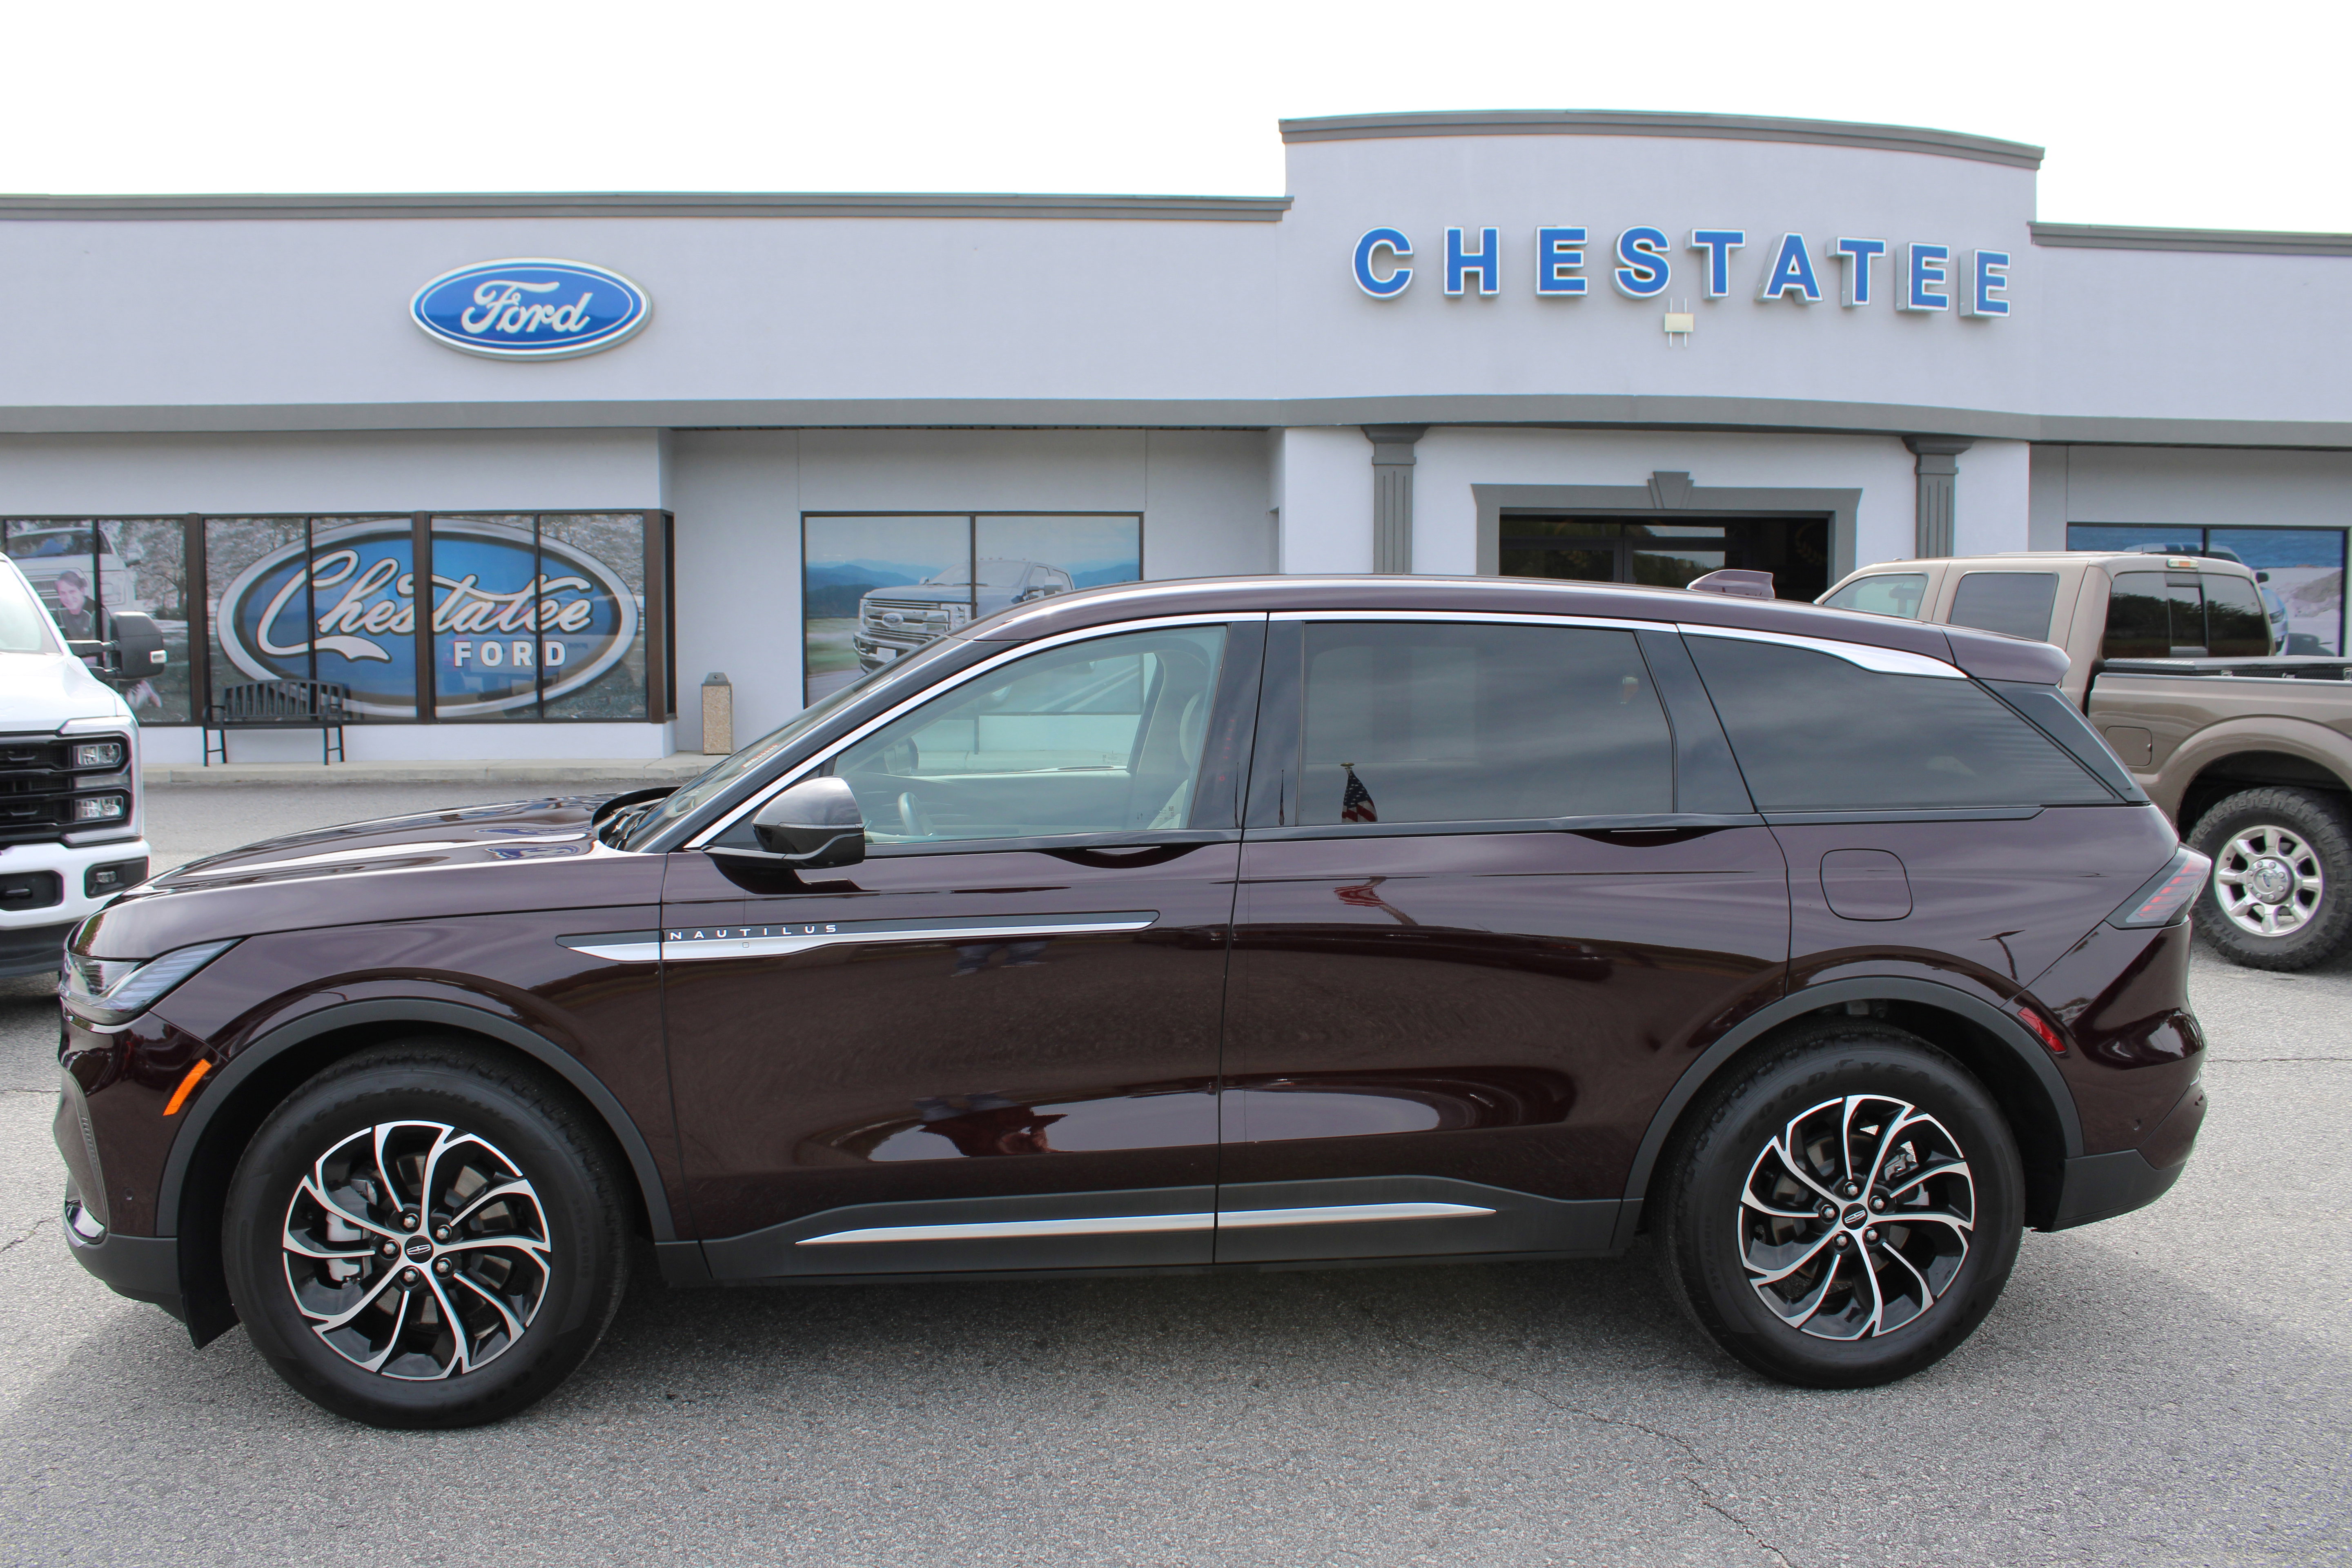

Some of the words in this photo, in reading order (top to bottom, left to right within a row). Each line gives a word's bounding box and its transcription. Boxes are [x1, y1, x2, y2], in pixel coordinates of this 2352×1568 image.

[1351, 224, 2011, 318] CHESTATEE
[461, 280, 593, 334] Ford
[454, 641, 566, 666] FORD
[669, 924, 837, 940] NAUTILUS
[1738, 1060, 1959, 1144] GOODYEAR
